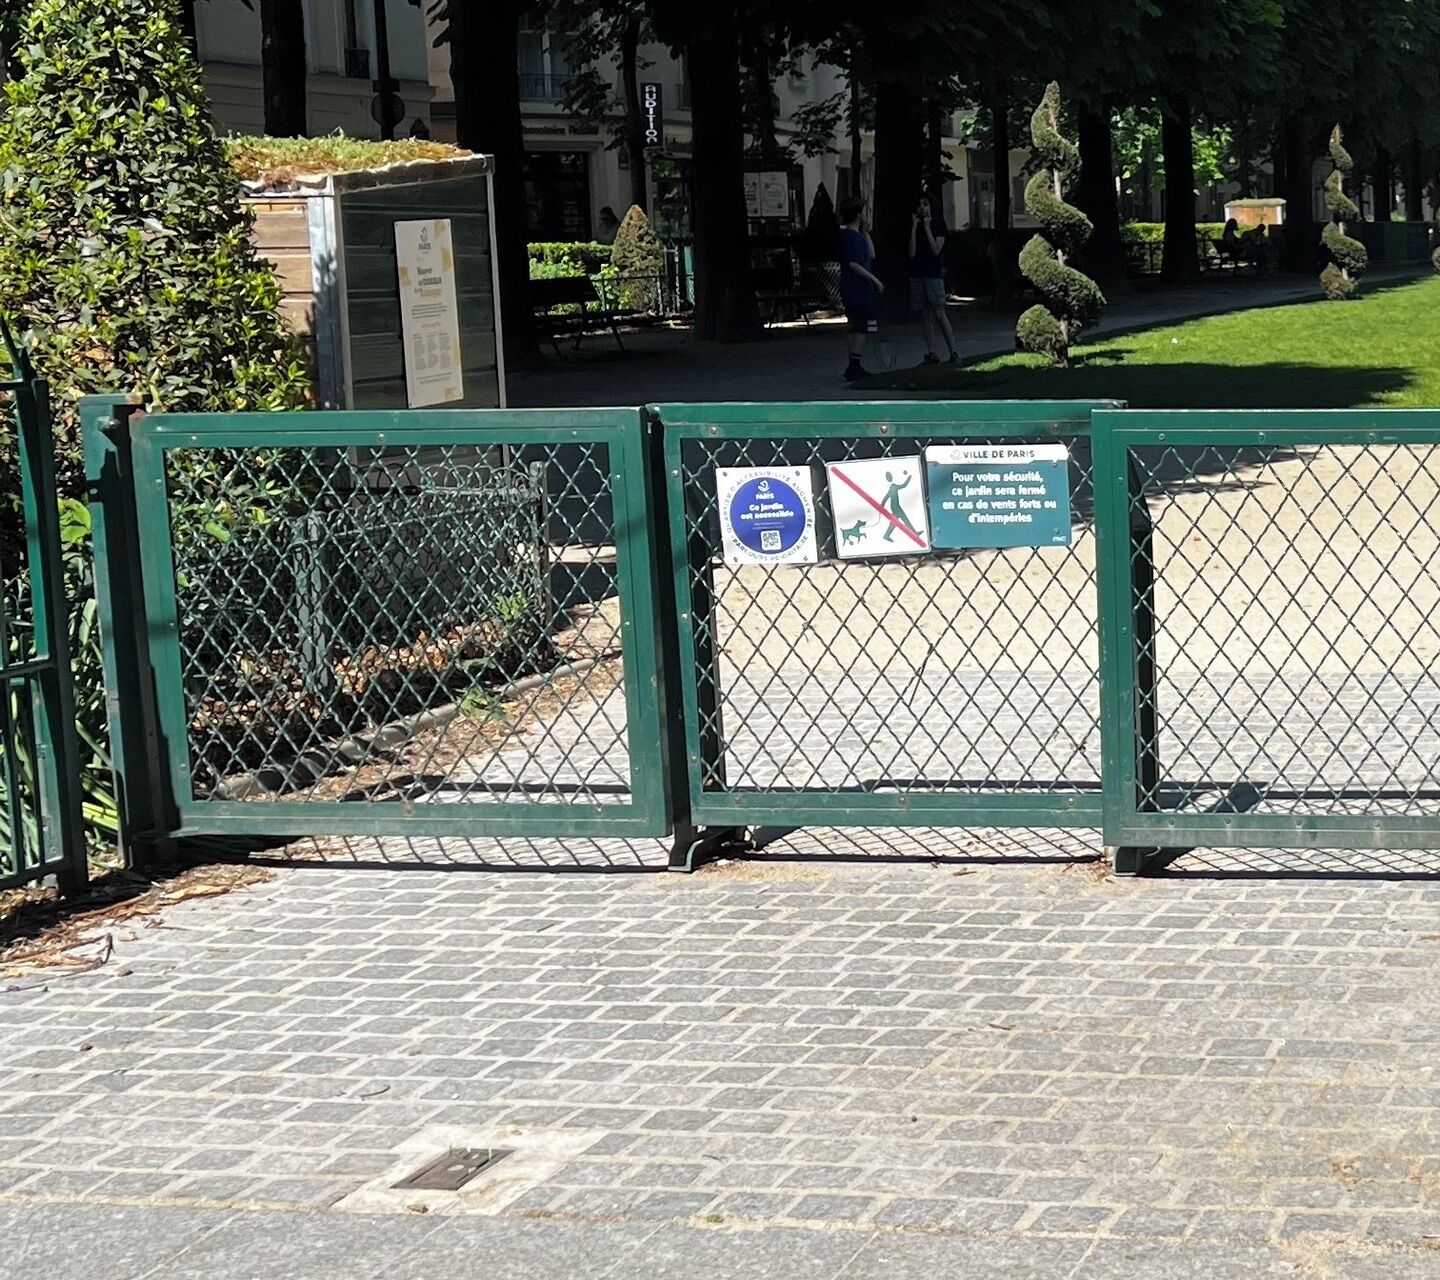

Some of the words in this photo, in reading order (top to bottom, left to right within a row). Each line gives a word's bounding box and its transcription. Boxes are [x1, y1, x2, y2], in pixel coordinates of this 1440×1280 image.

[645, 84, 658, 145] AUDITION
[963, 451, 989, 459] VILLE
[991, 450, 1004, 458] DE
[1007, 450, 1035, 458] PARIS
[952, 472, 974, 482] Pour
[976, 472, 1000, 482] votre
[1003, 470, 1044, 483] sécurité,
[951, 487, 962, 496] ce
[965, 485, 992, 497] jardin
[995, 486, 1016, 496] sera
[1018, 484, 1046, 496] fermé
[942, 501, 954, 509] en
[957, 501, 973, 509] cas
[976, 499, 988, 509] de
[991, 499, 1016, 509] vents
[1019, 498, 1042, 509] forts
[1044, 500, 1057, 509] ou
[968, 512, 1033, 525] d'intempéries
